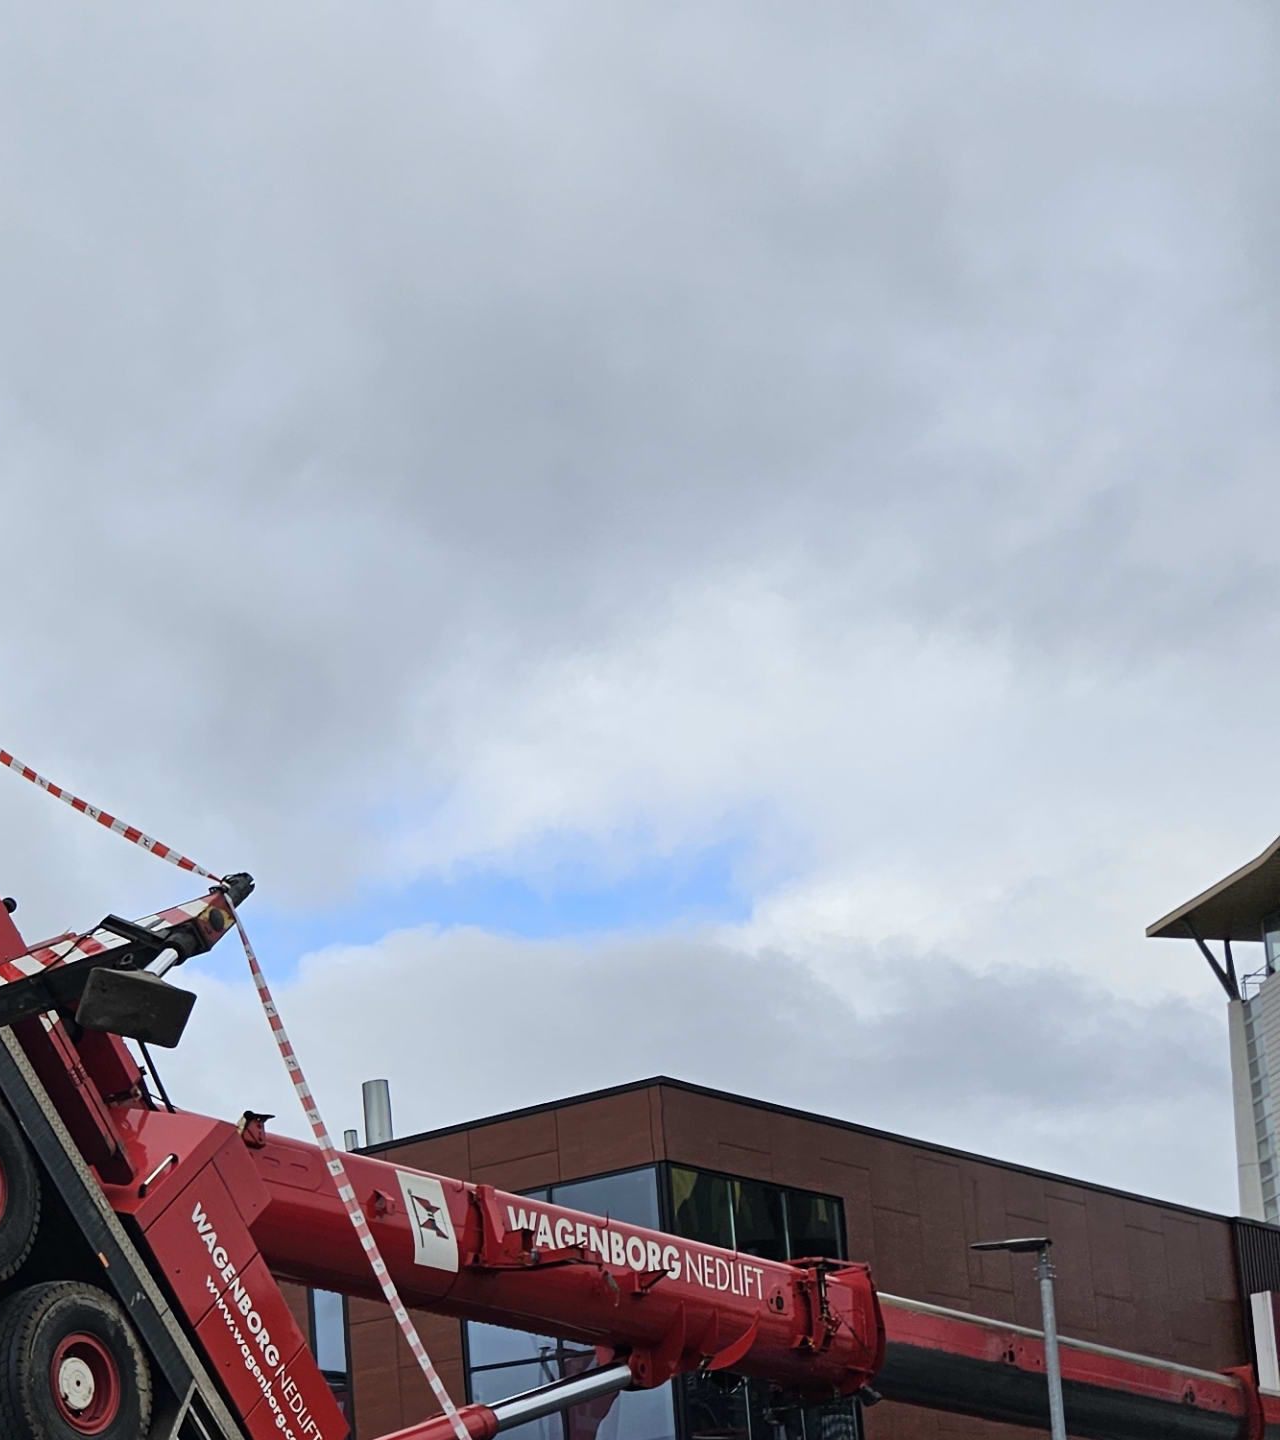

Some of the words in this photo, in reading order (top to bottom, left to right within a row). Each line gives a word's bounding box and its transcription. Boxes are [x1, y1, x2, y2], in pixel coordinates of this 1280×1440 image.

[191, 1202, 280, 1367] WAGENBORG
[507, 1205, 681, 1280] WAGENBORG
[685, 1250, 764, 1300] NEDLIFT
